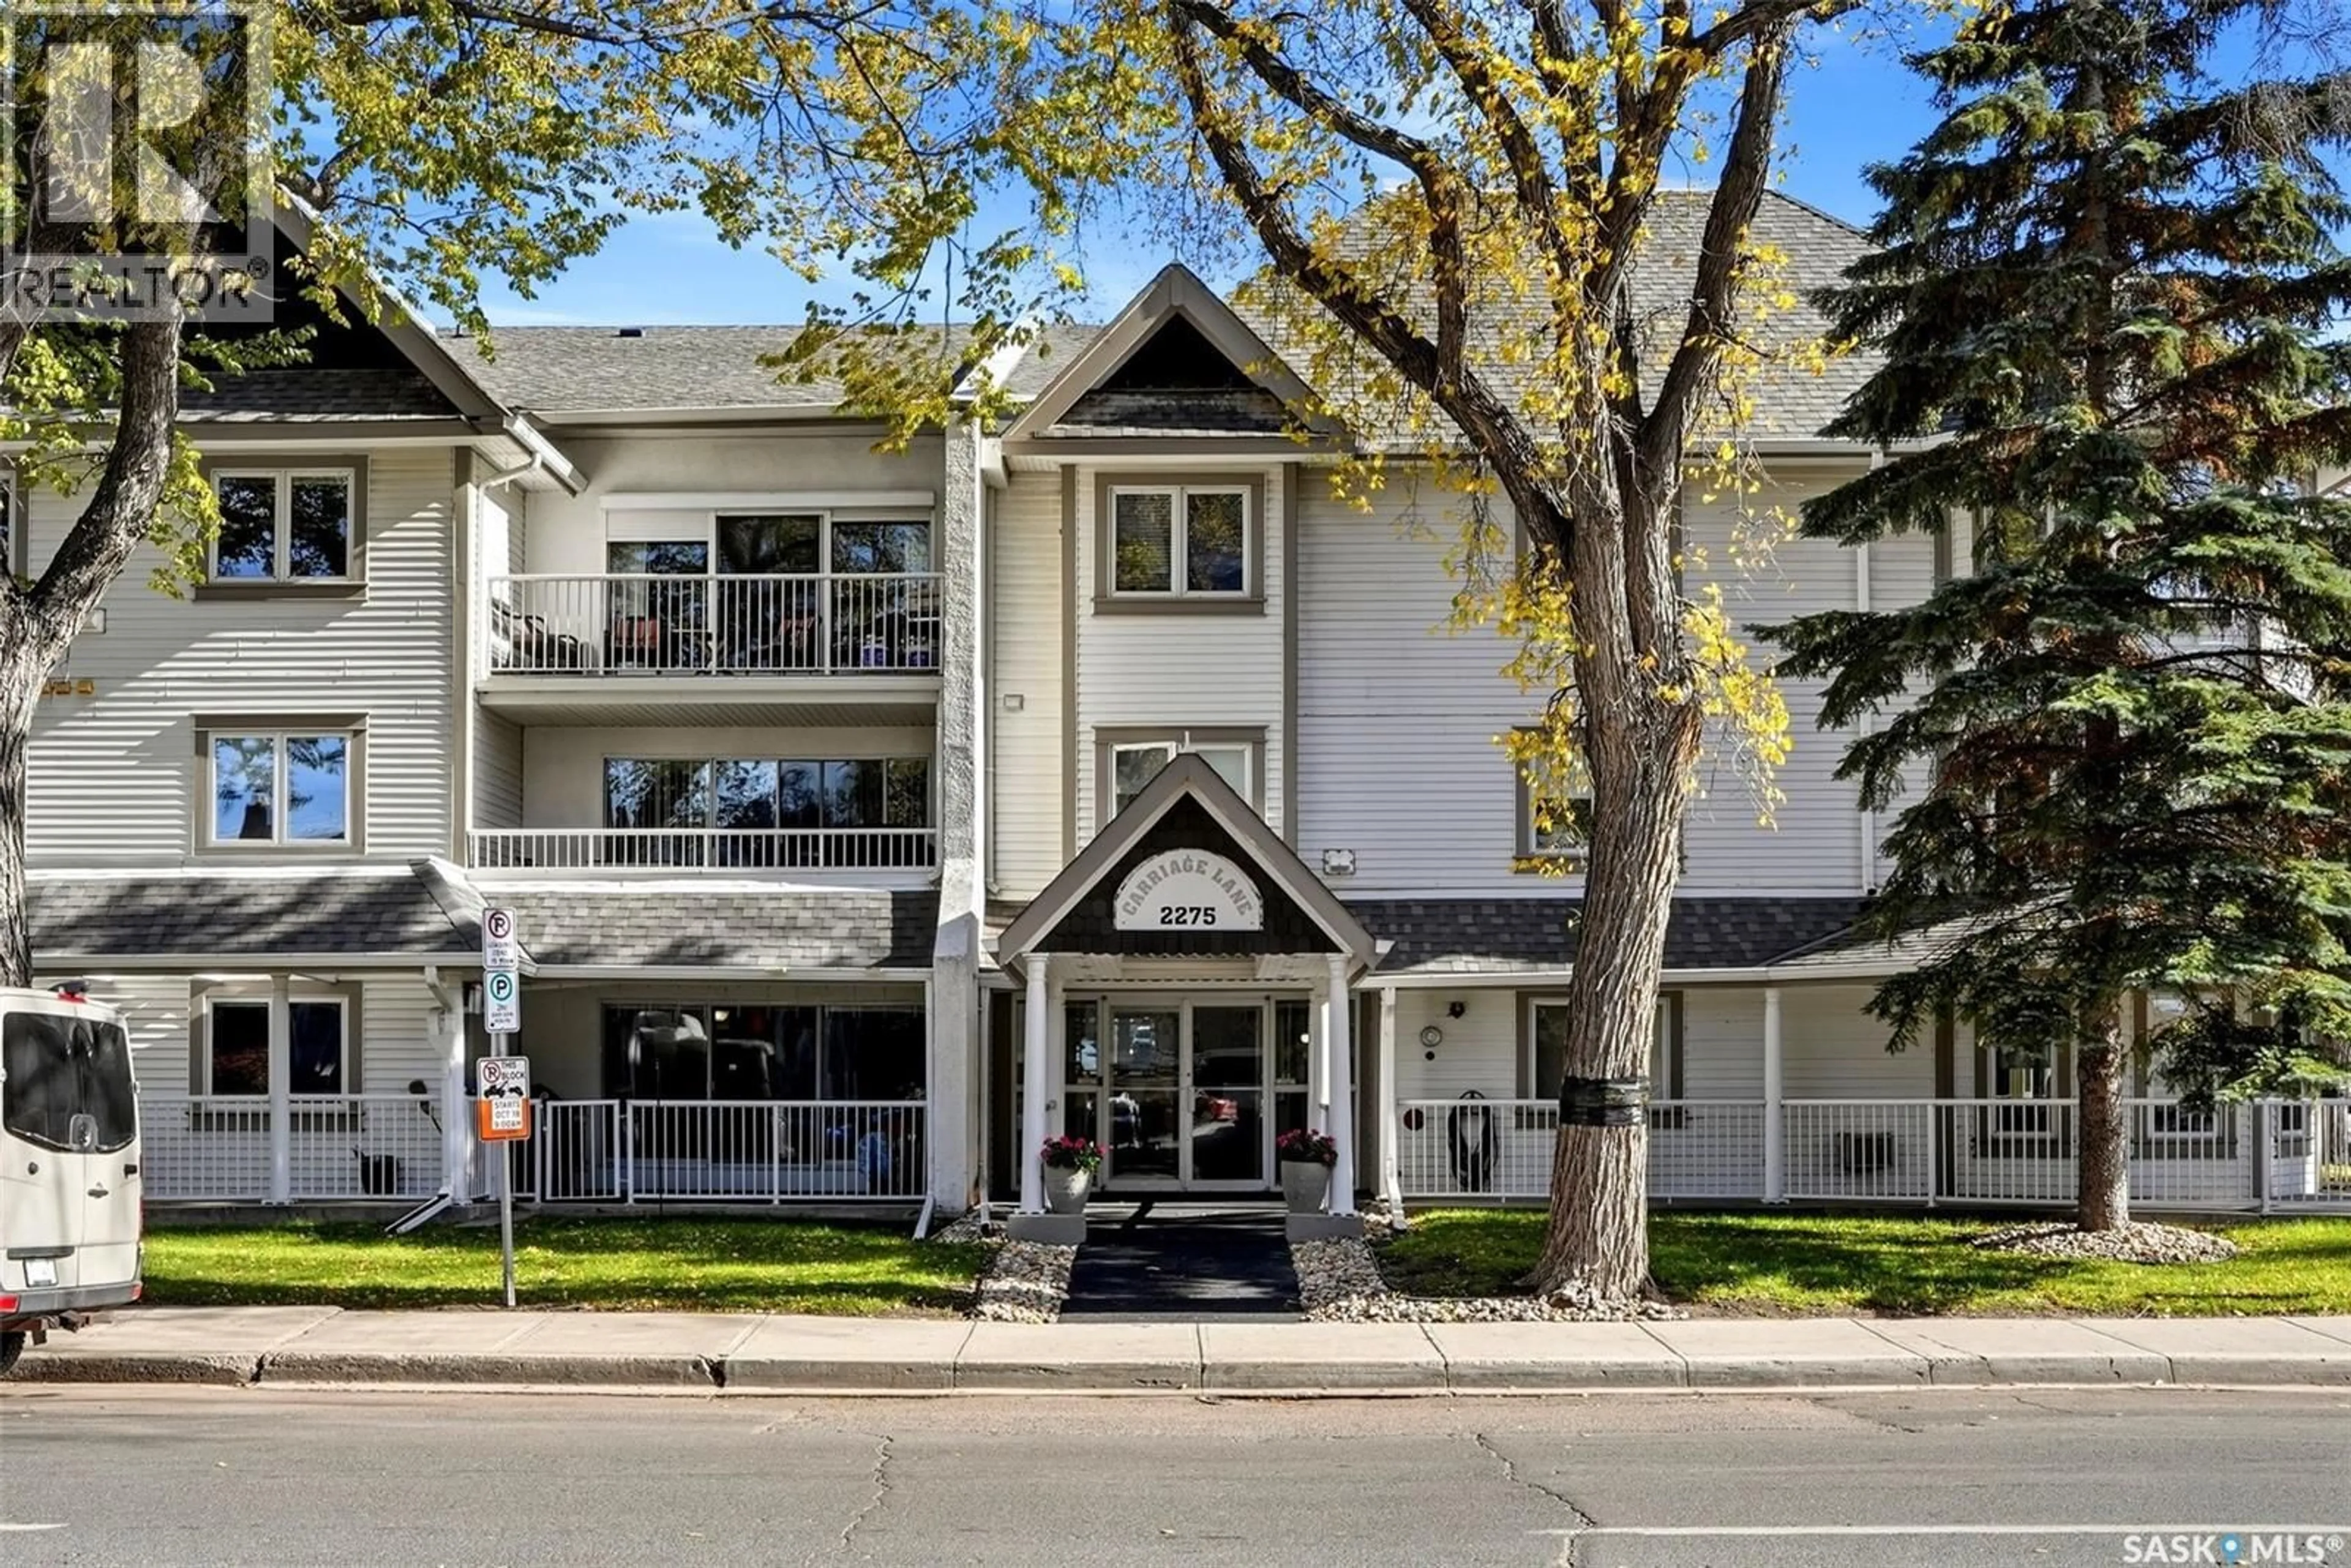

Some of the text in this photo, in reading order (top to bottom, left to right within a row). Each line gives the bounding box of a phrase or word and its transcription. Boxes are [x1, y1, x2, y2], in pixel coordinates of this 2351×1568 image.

[1122, 856, 1253, 916] CARRIAGE LANE
[1160, 906, 1217, 925] 2275
